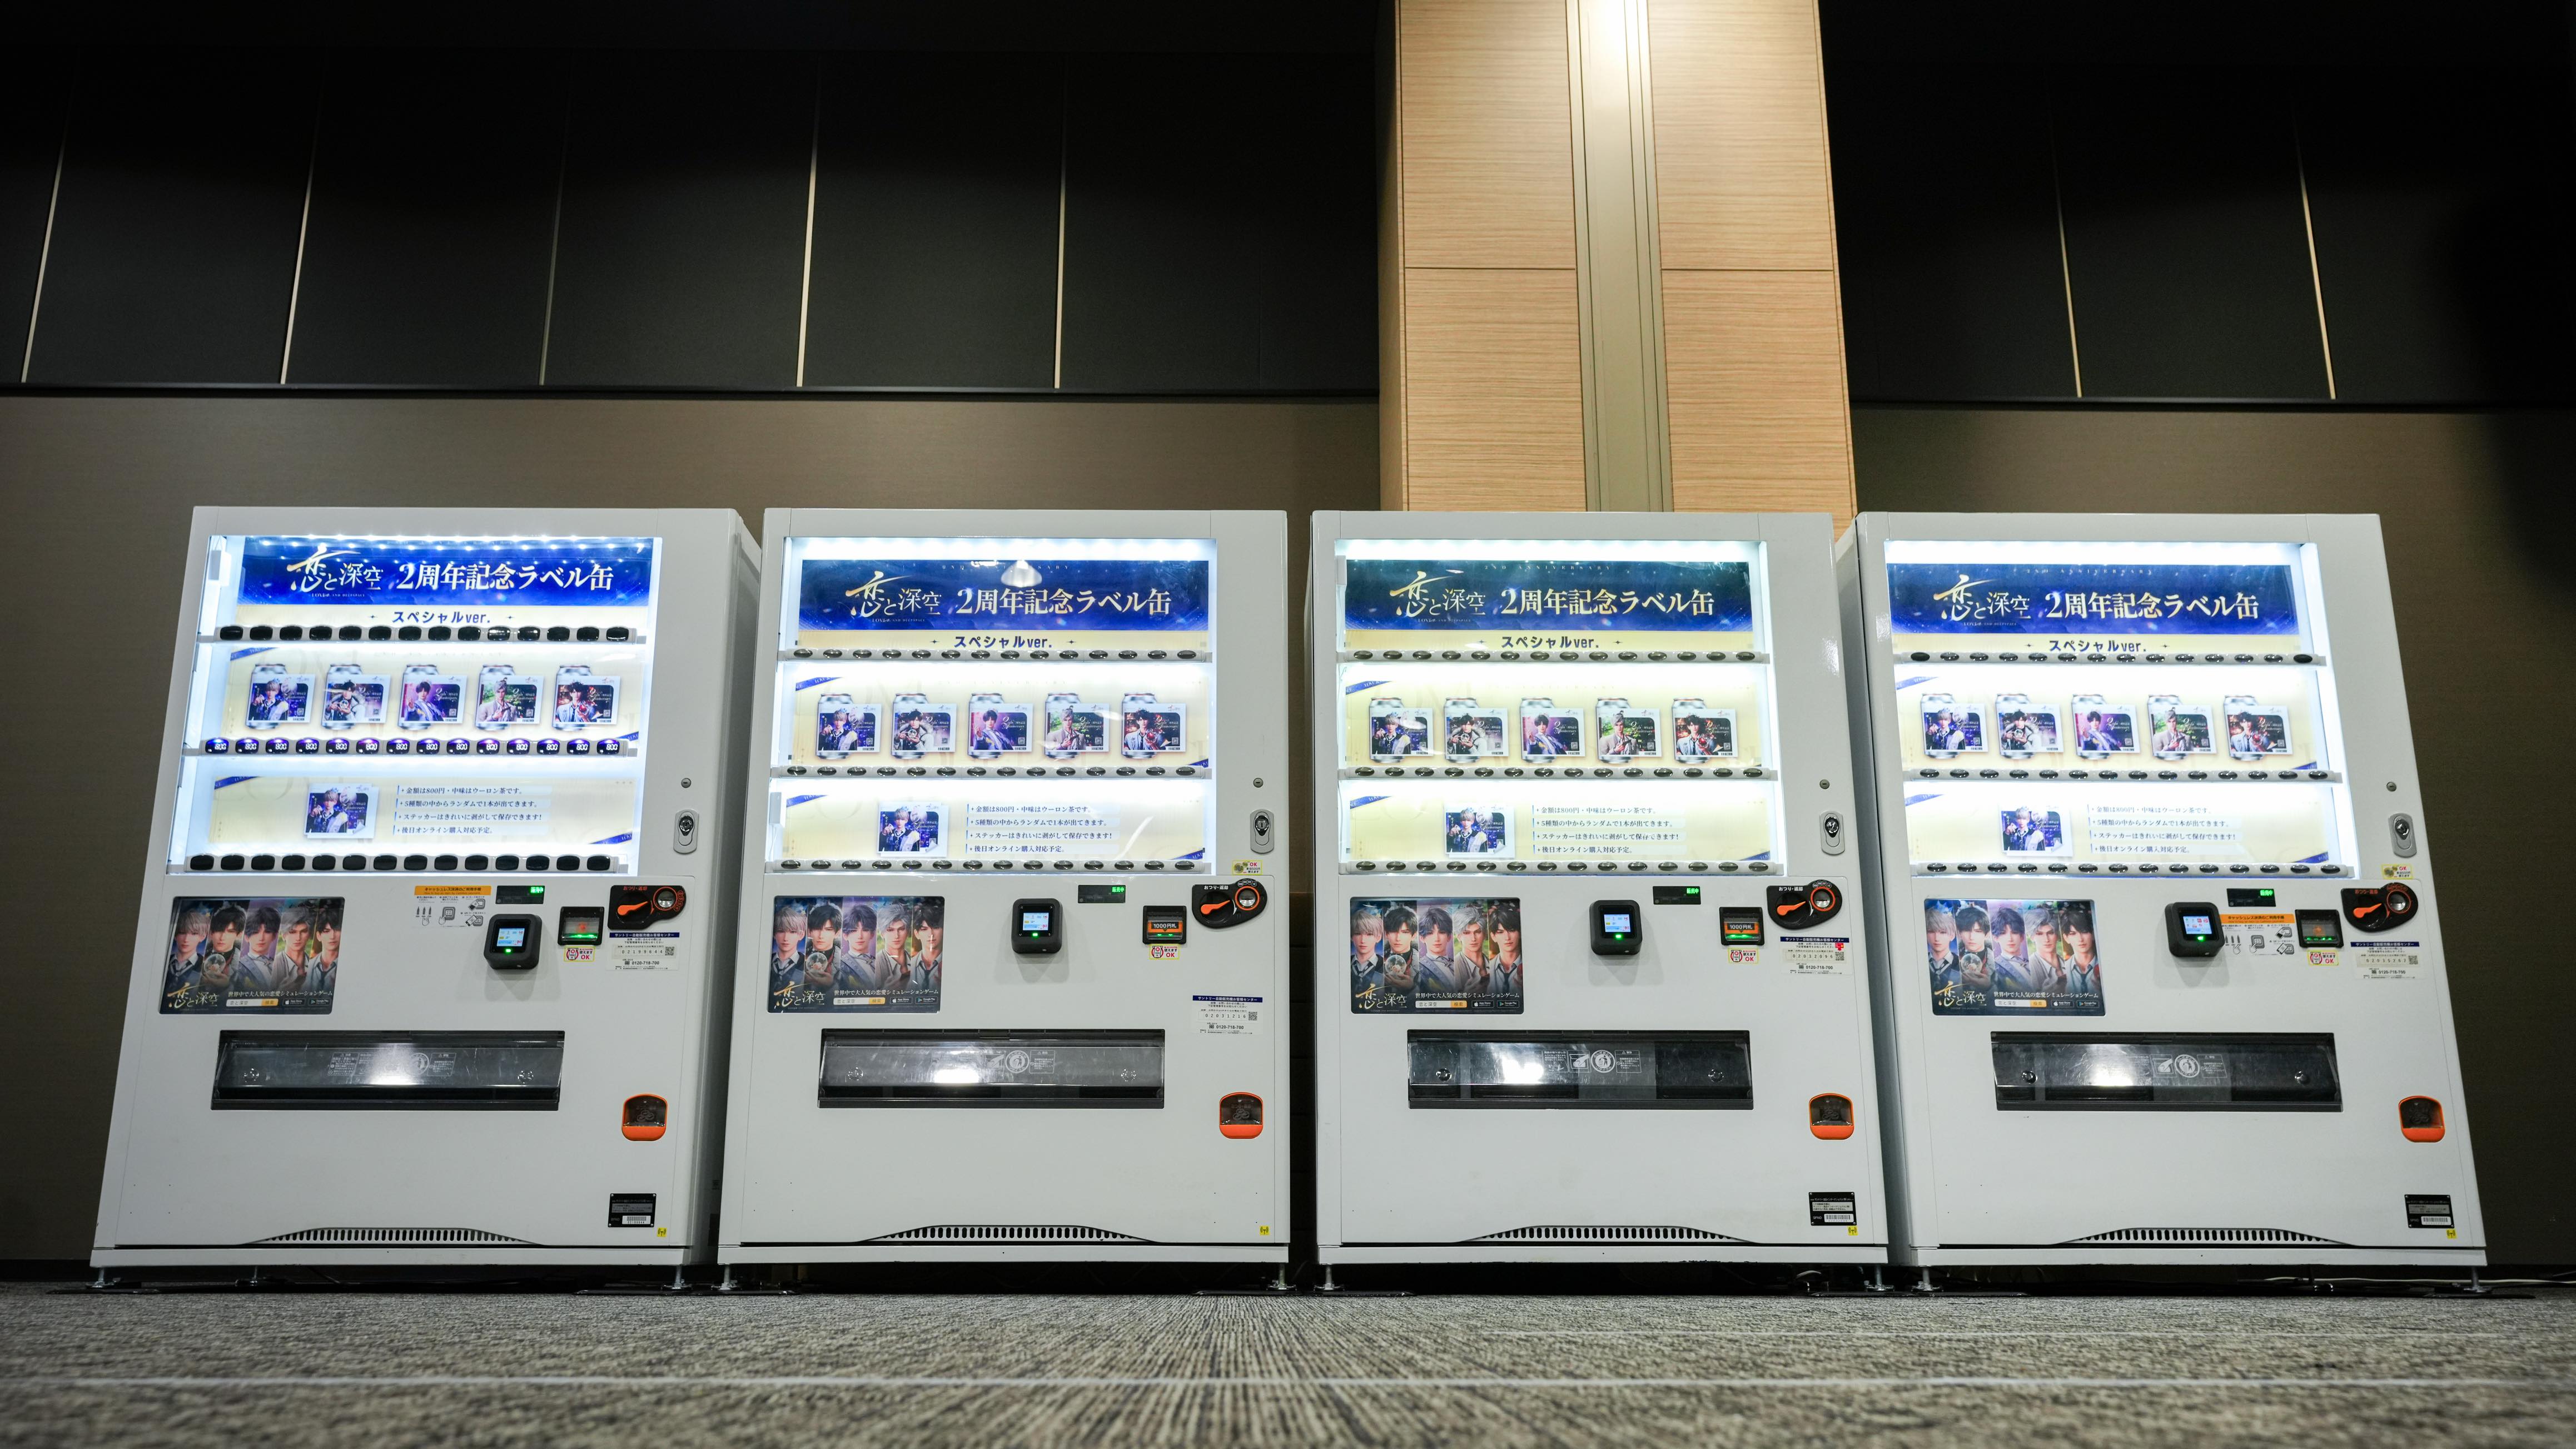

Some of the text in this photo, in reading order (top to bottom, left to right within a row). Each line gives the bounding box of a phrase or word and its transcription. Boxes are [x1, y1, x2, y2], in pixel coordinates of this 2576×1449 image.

[286, 544, 384, 592] 恋と深空
[397, 562, 613, 592] 2周年記念ラベル缶
[846, 570, 941, 617] 恋と深空
[957, 588, 1172, 615] 2周年記念ラベル缶
[1390, 570, 1485, 617] 恋と深空
[1501, 588, 1713, 616] 2周年記念ラベル缶
[1933, 574, 2031, 621] 恋と深空
[2045, 592, 2258, 619] 2周年記念ラベル缶
[392, 611, 490, 623] スペシャルver.
[954, 636, 1052, 648] スペシャルver.
[1501, 636, 1599, 648] スペシャルver.
[2049, 640, 2146, 652] スペシャルver.
[774, 981, 825, 1006] 恋と深空
[1355, 984, 1408, 1009] 恋と深空
[1935, 980, 1987, 1006] 恋と深空
